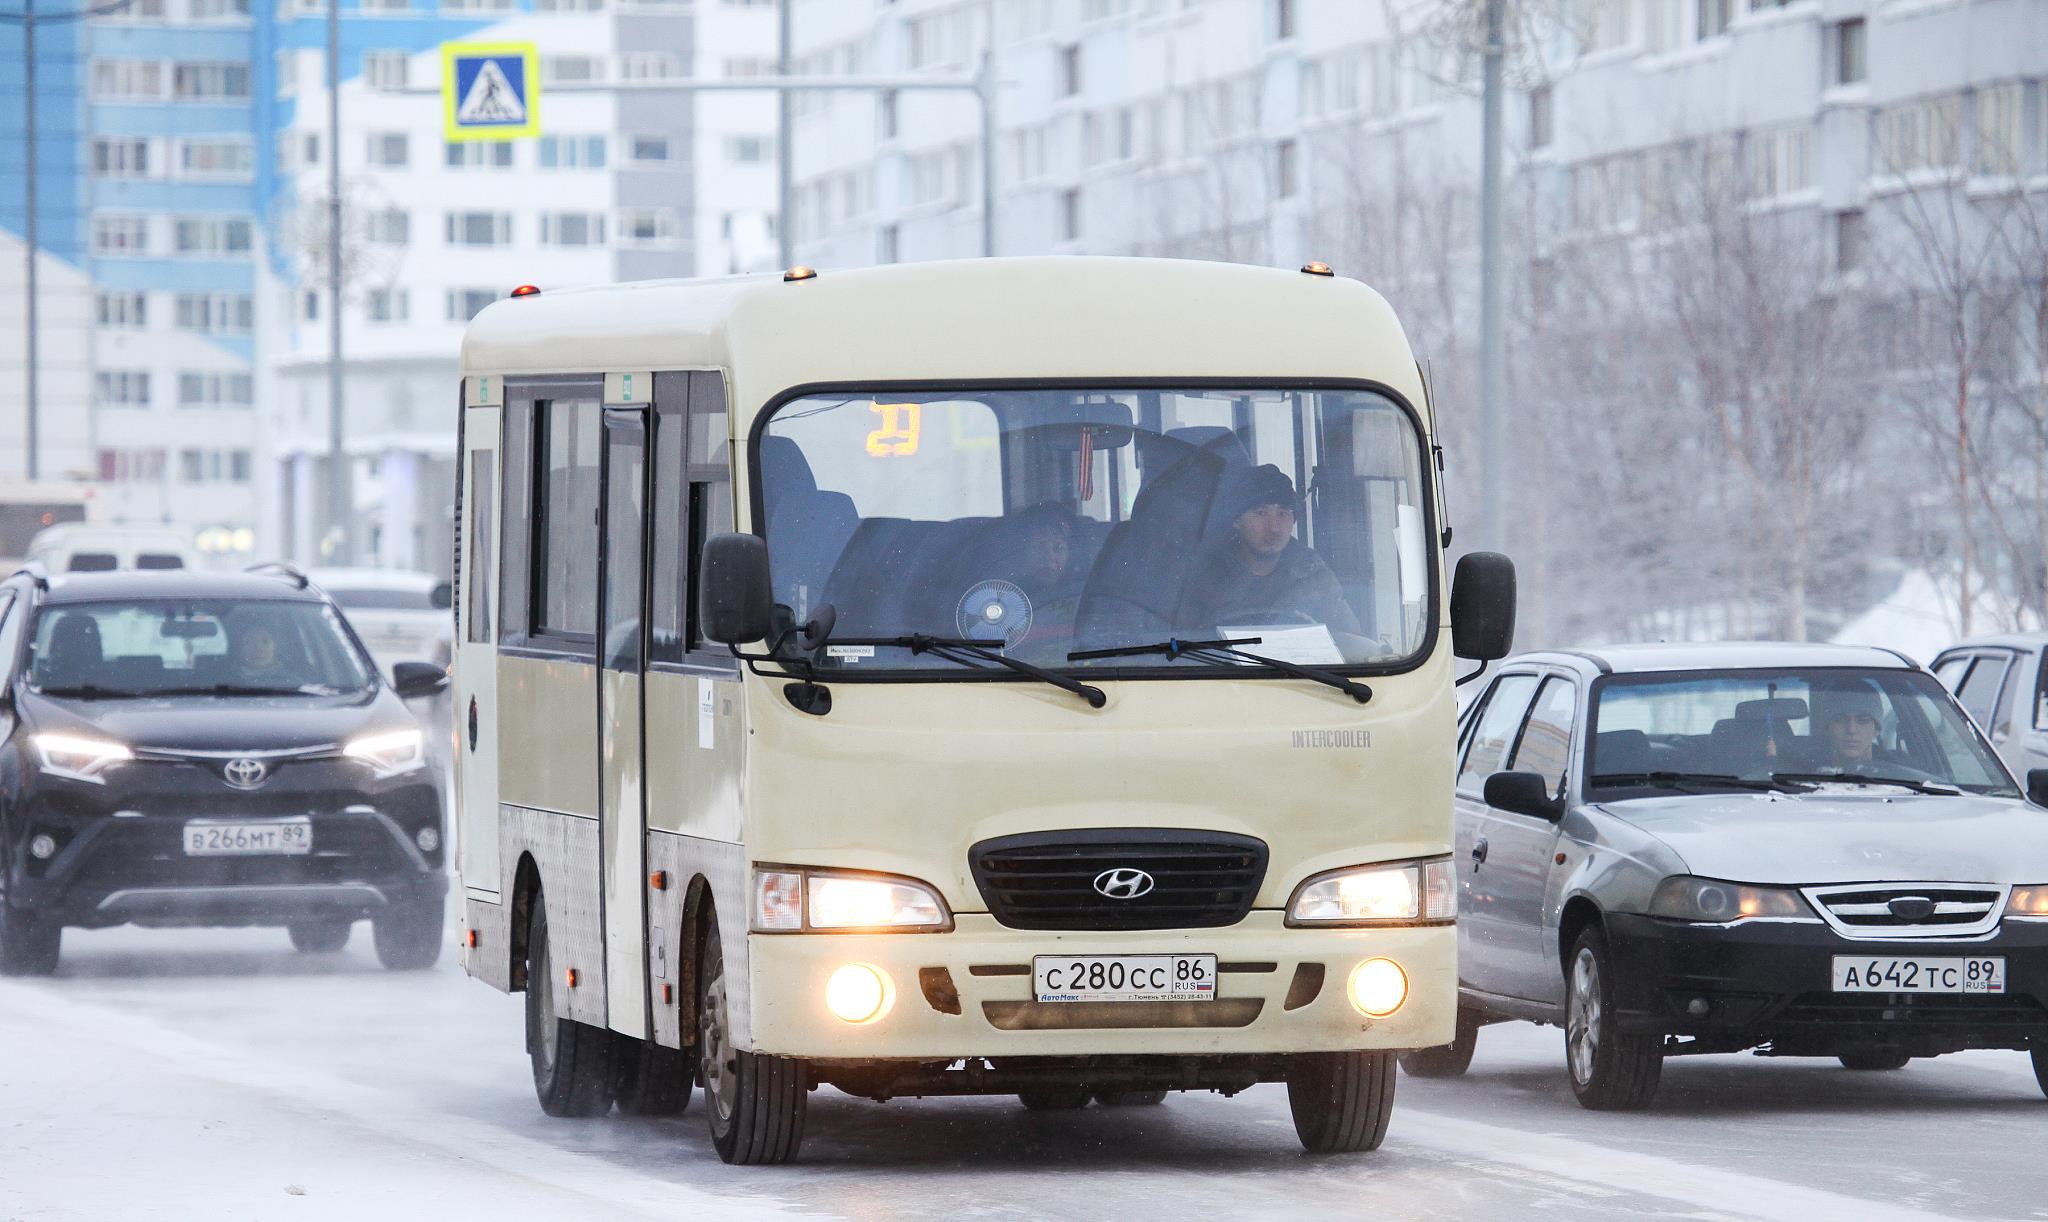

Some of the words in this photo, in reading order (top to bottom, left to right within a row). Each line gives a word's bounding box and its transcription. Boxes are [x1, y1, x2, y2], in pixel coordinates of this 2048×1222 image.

[1292, 730, 1371, 748] INTERCOOLER
[192, 828, 275, 849] В266МТ
[282, 826, 304, 842] 89
[1046, 962, 1166, 990] С280СС
[1176, 959, 1205, 981] 86
[1844, 960, 1958, 988] А642ТС
[1967, 960, 1995, 981] 89
[1175, 982, 1196, 990] RUS
[1966, 981, 1986, 990] RUS
